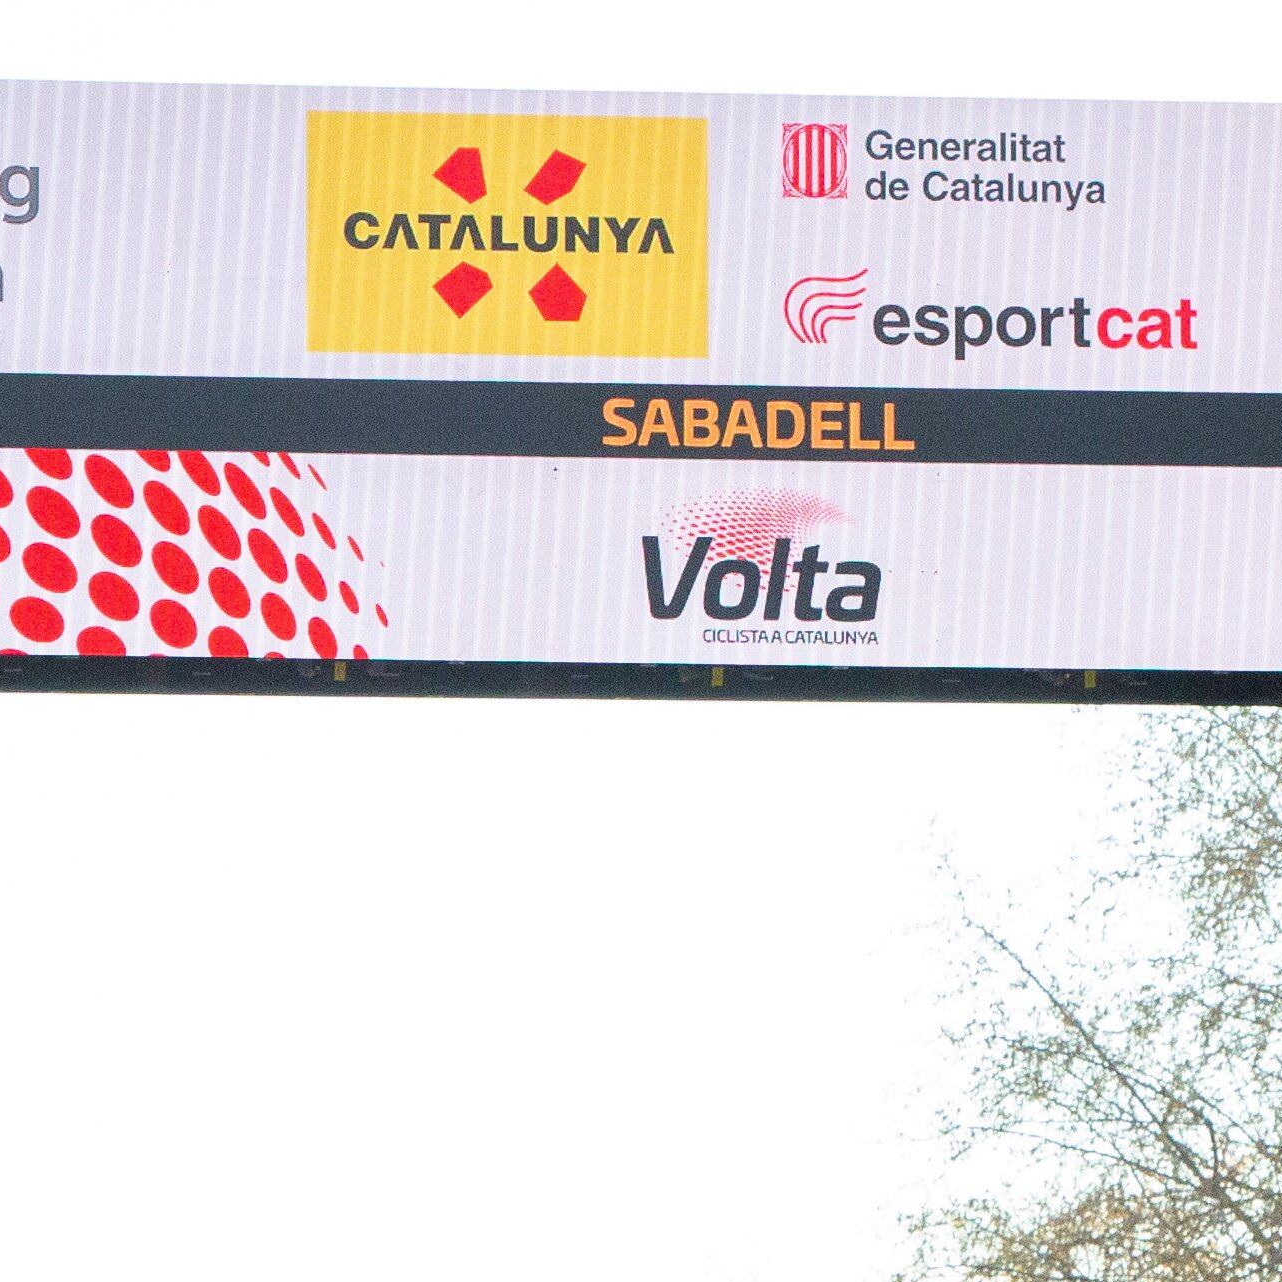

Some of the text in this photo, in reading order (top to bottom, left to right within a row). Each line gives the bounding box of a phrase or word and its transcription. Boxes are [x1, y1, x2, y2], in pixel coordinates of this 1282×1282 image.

[866, 129, 1065, 164] Generalitat
[866, 171, 1107, 210] de Catalunya
[343, 211, 675, 255] CATALUNYA
[873, 297, 1197, 360] esportcat
[603, 398, 915, 451] SABADELL
[642, 535, 881, 623] Volta
[702, 629, 769, 644] CICLISTA
[785, 630, 879, 645] CATALUNYA
